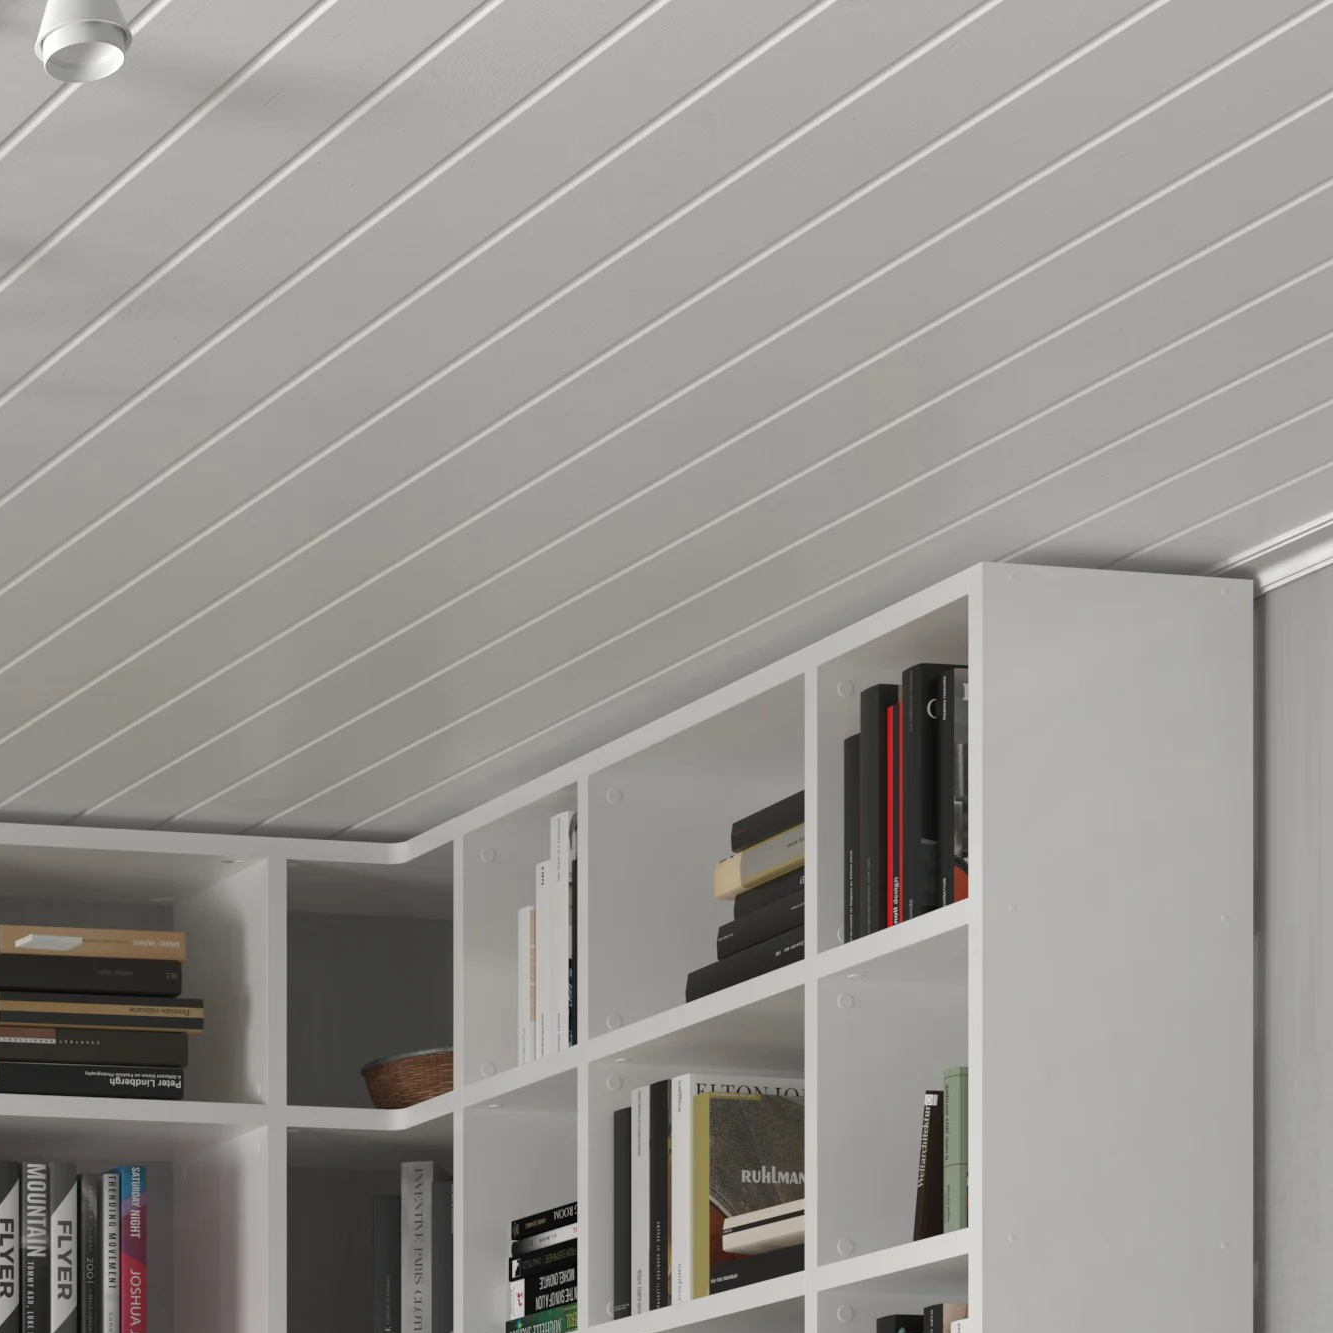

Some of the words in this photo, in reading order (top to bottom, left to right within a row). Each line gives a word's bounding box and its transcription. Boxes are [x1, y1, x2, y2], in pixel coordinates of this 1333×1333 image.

[917, 1105, 932, 1188] Weltarchitektur
[27, 1163, 47, 1257] MOUNTAIN
[108, 1175, 117, 1227] TRENDING
[130, 1166, 141, 1207] SATURDAY
[130, 1209, 141, 1239] NIGHT
[0, 1218, 14, 1298] FLYER
[58, 1220, 73, 1300] FLYER
[108, 1233, 117, 1290] MOVEMENT
[130, 1268, 142, 1326] JOSHUA
